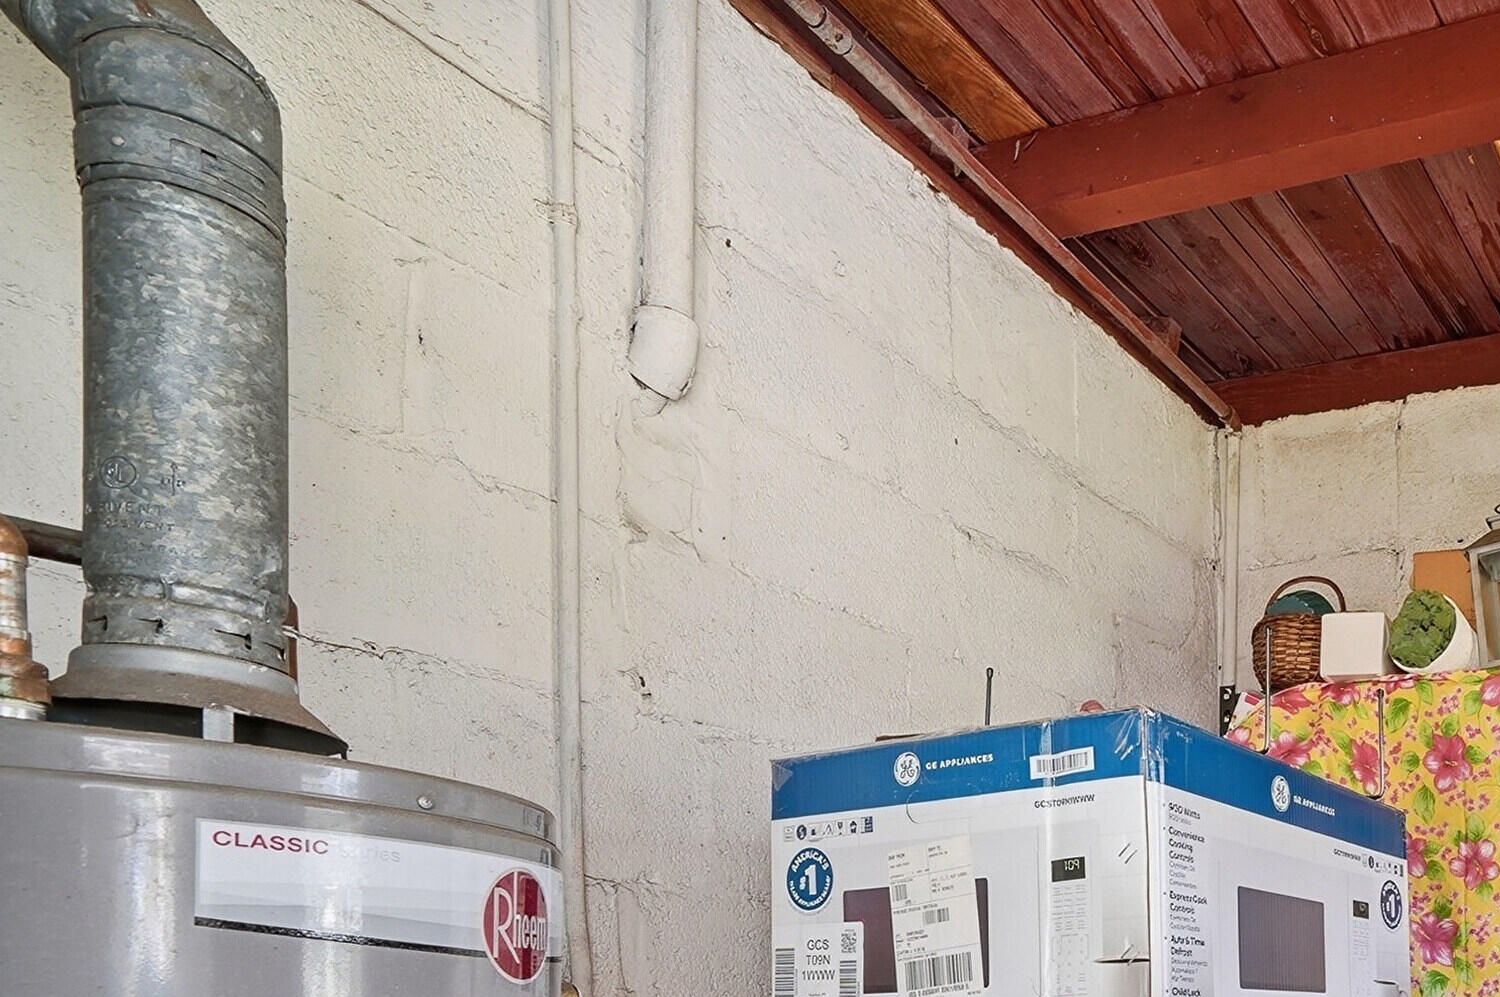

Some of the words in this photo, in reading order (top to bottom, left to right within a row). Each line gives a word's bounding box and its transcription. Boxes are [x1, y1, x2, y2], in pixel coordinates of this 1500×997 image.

[939, 754, 994, 769] APPLIANCES
[212, 830, 329, 856] CLASSIC
[493, 870, 547, 964] Rheem
[806, 938, 830, 951] GCS
[805, 954, 831, 966] T09N
